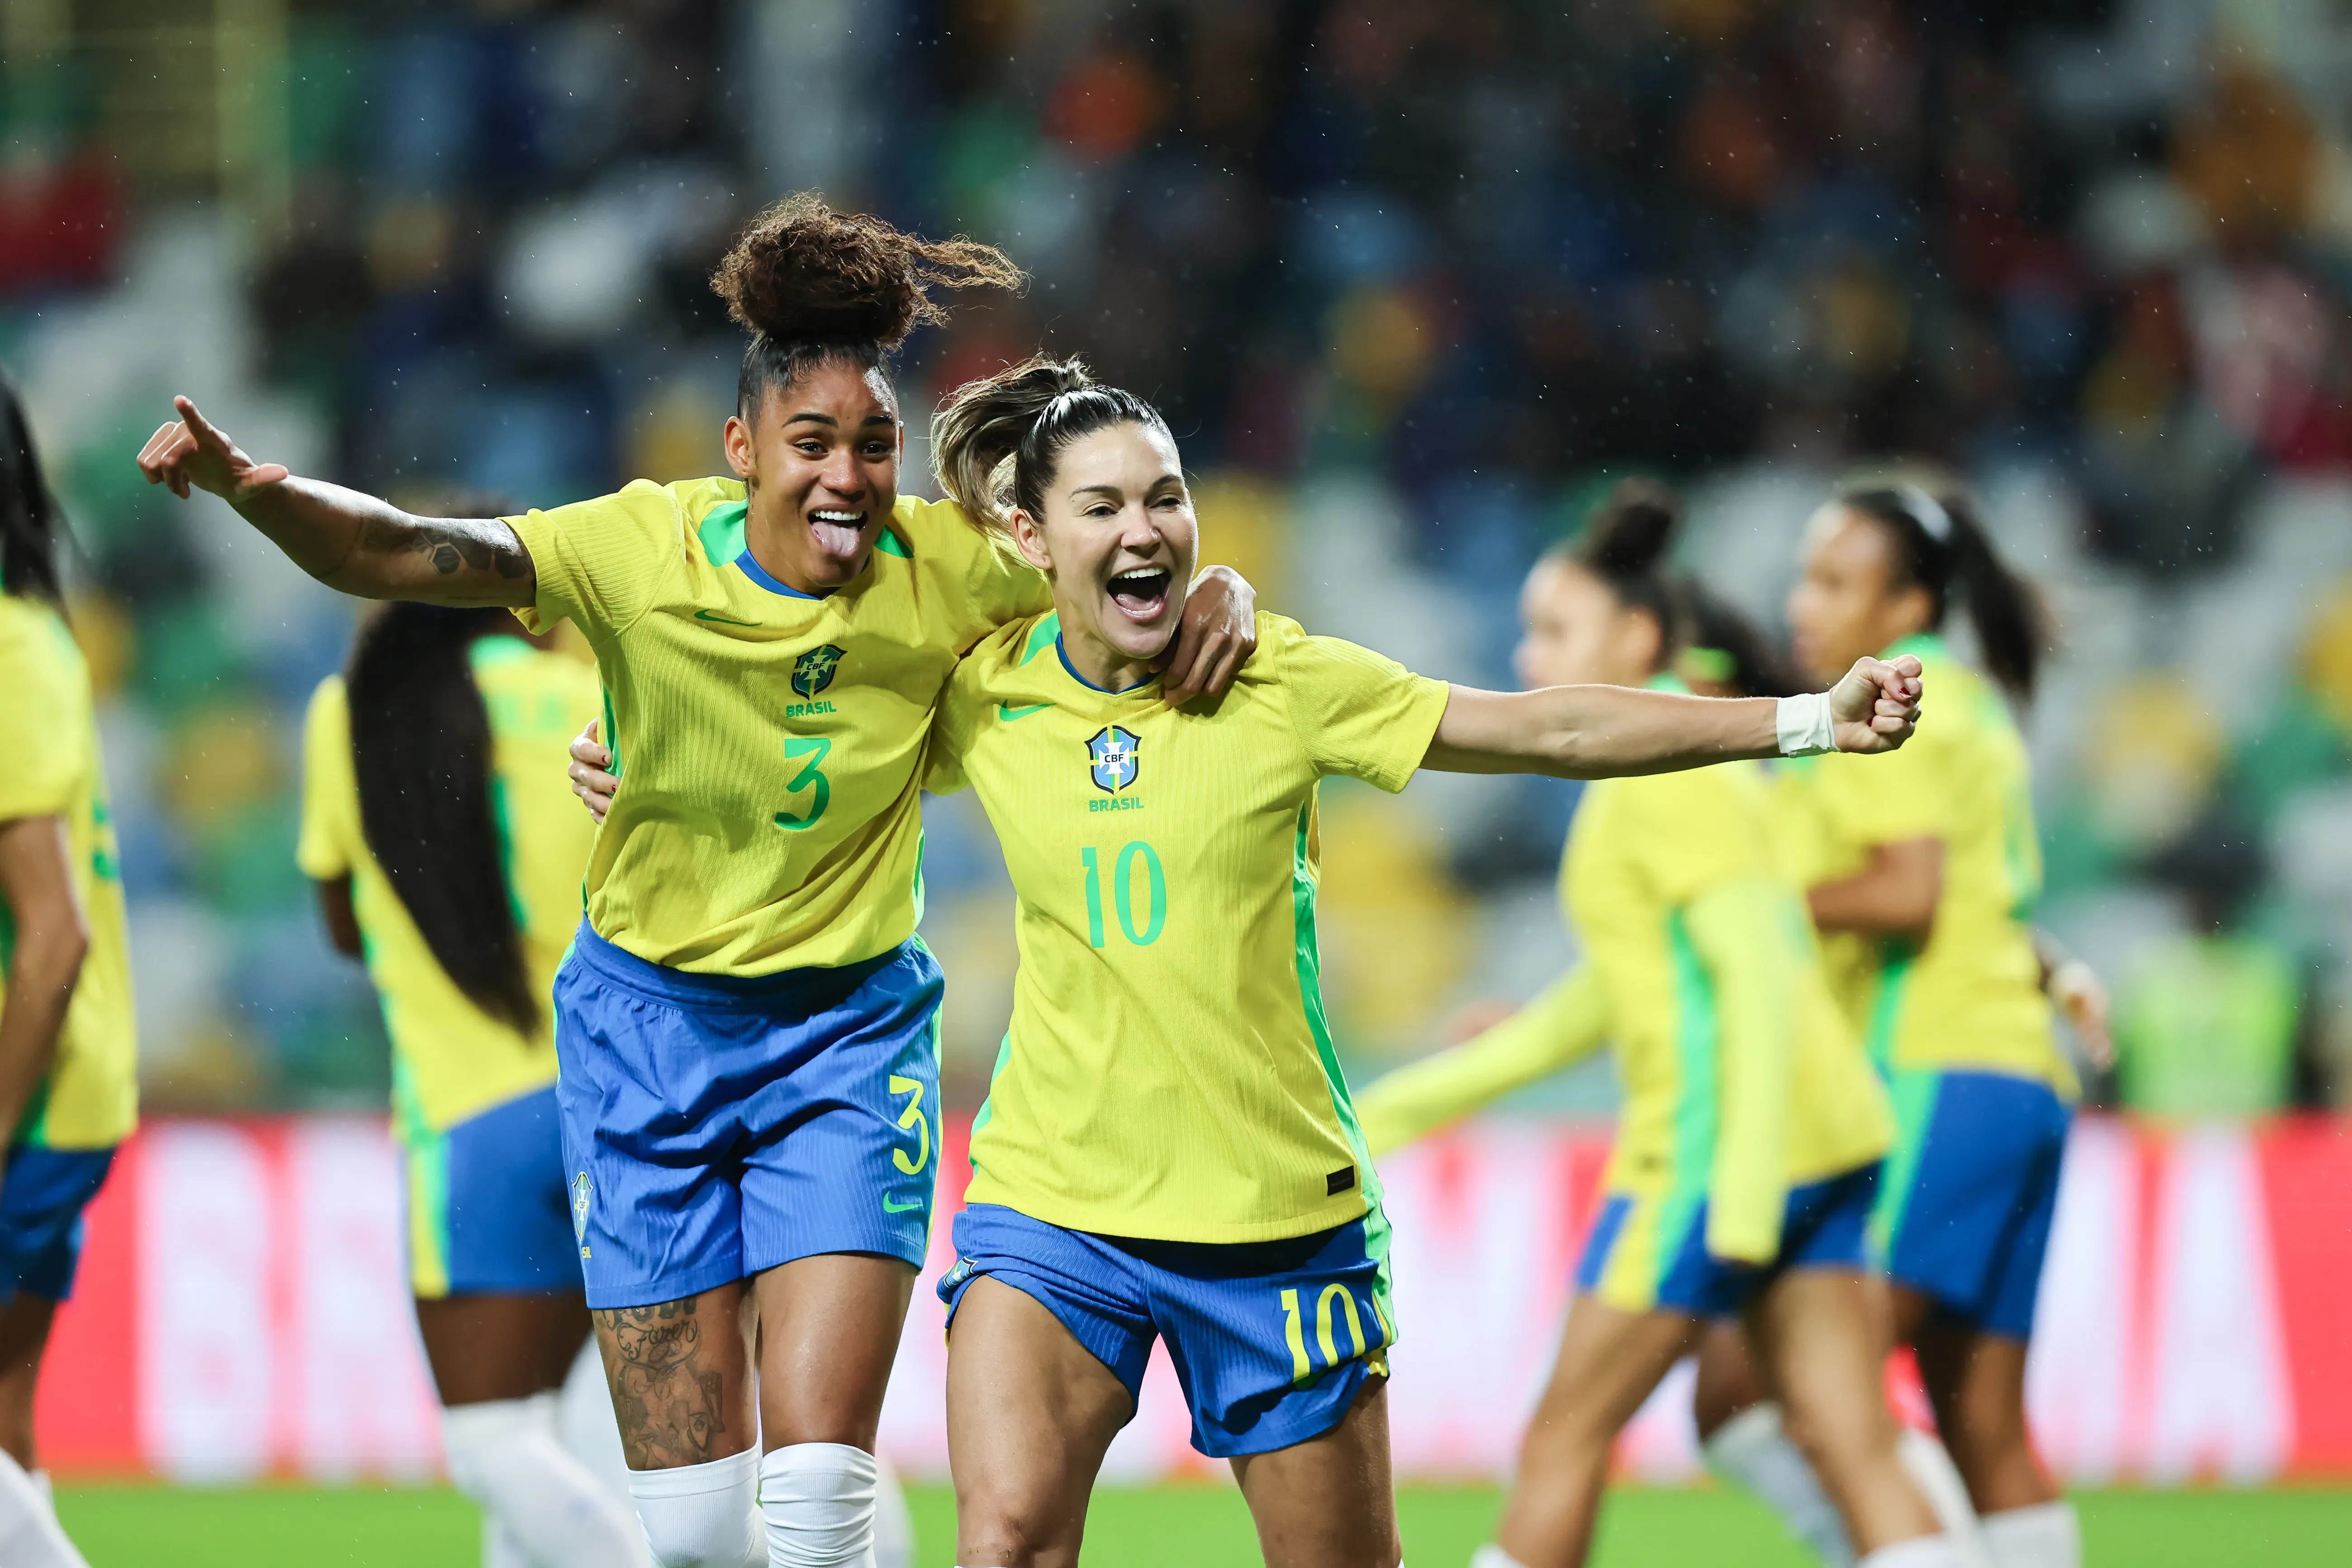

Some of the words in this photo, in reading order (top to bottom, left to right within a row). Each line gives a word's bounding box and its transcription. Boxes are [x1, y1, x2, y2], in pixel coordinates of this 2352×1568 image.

[806, 662, 825, 670] CBF
[786, 701, 837, 717] BRASIL
[1104, 754, 1124, 763] CBF
[774, 738, 831, 830] 3
[1089, 797, 1144, 812] BRASIL
[1081, 841, 1166, 947] 10
[889, 1074, 930, 1175] 3
[582, 1246, 592, 1258] SIL
[1280, 1283, 1366, 1383] 10
